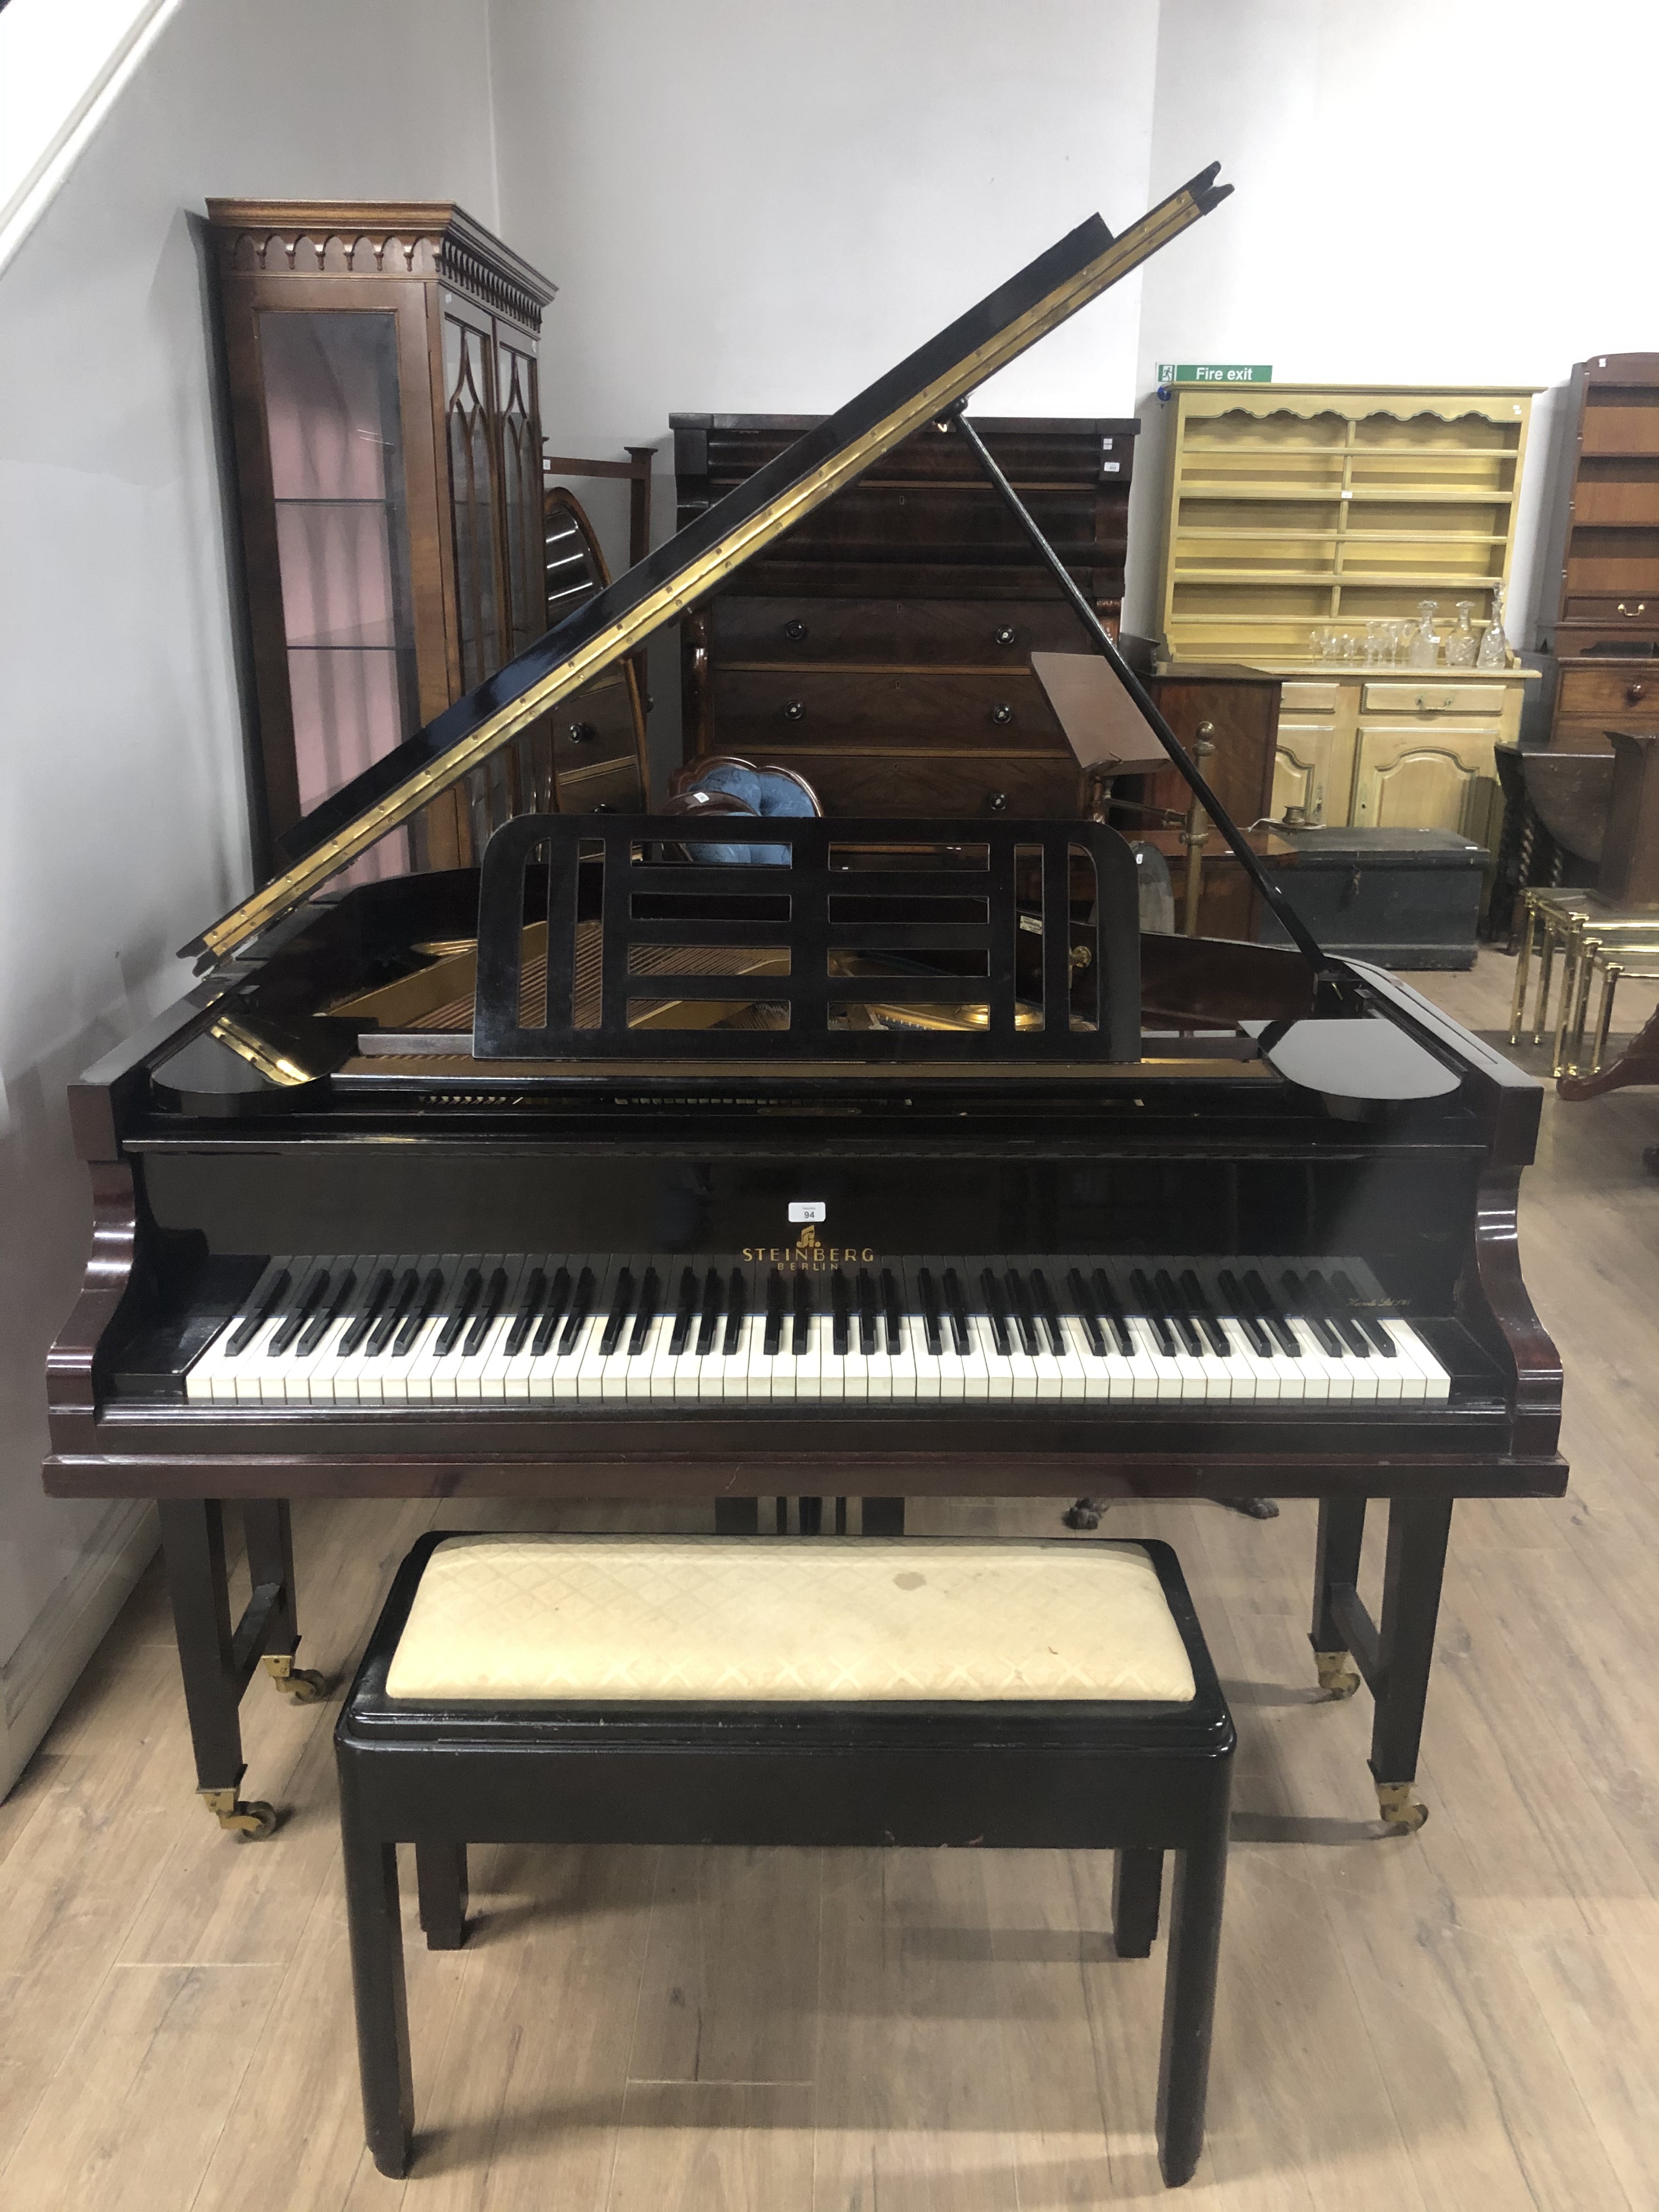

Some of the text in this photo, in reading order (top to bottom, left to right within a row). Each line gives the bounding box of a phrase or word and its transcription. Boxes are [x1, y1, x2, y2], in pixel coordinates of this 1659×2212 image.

[1196, 367, 1253, 380] Fire exit
[742, 1248, 873, 1261] STEINBERG
